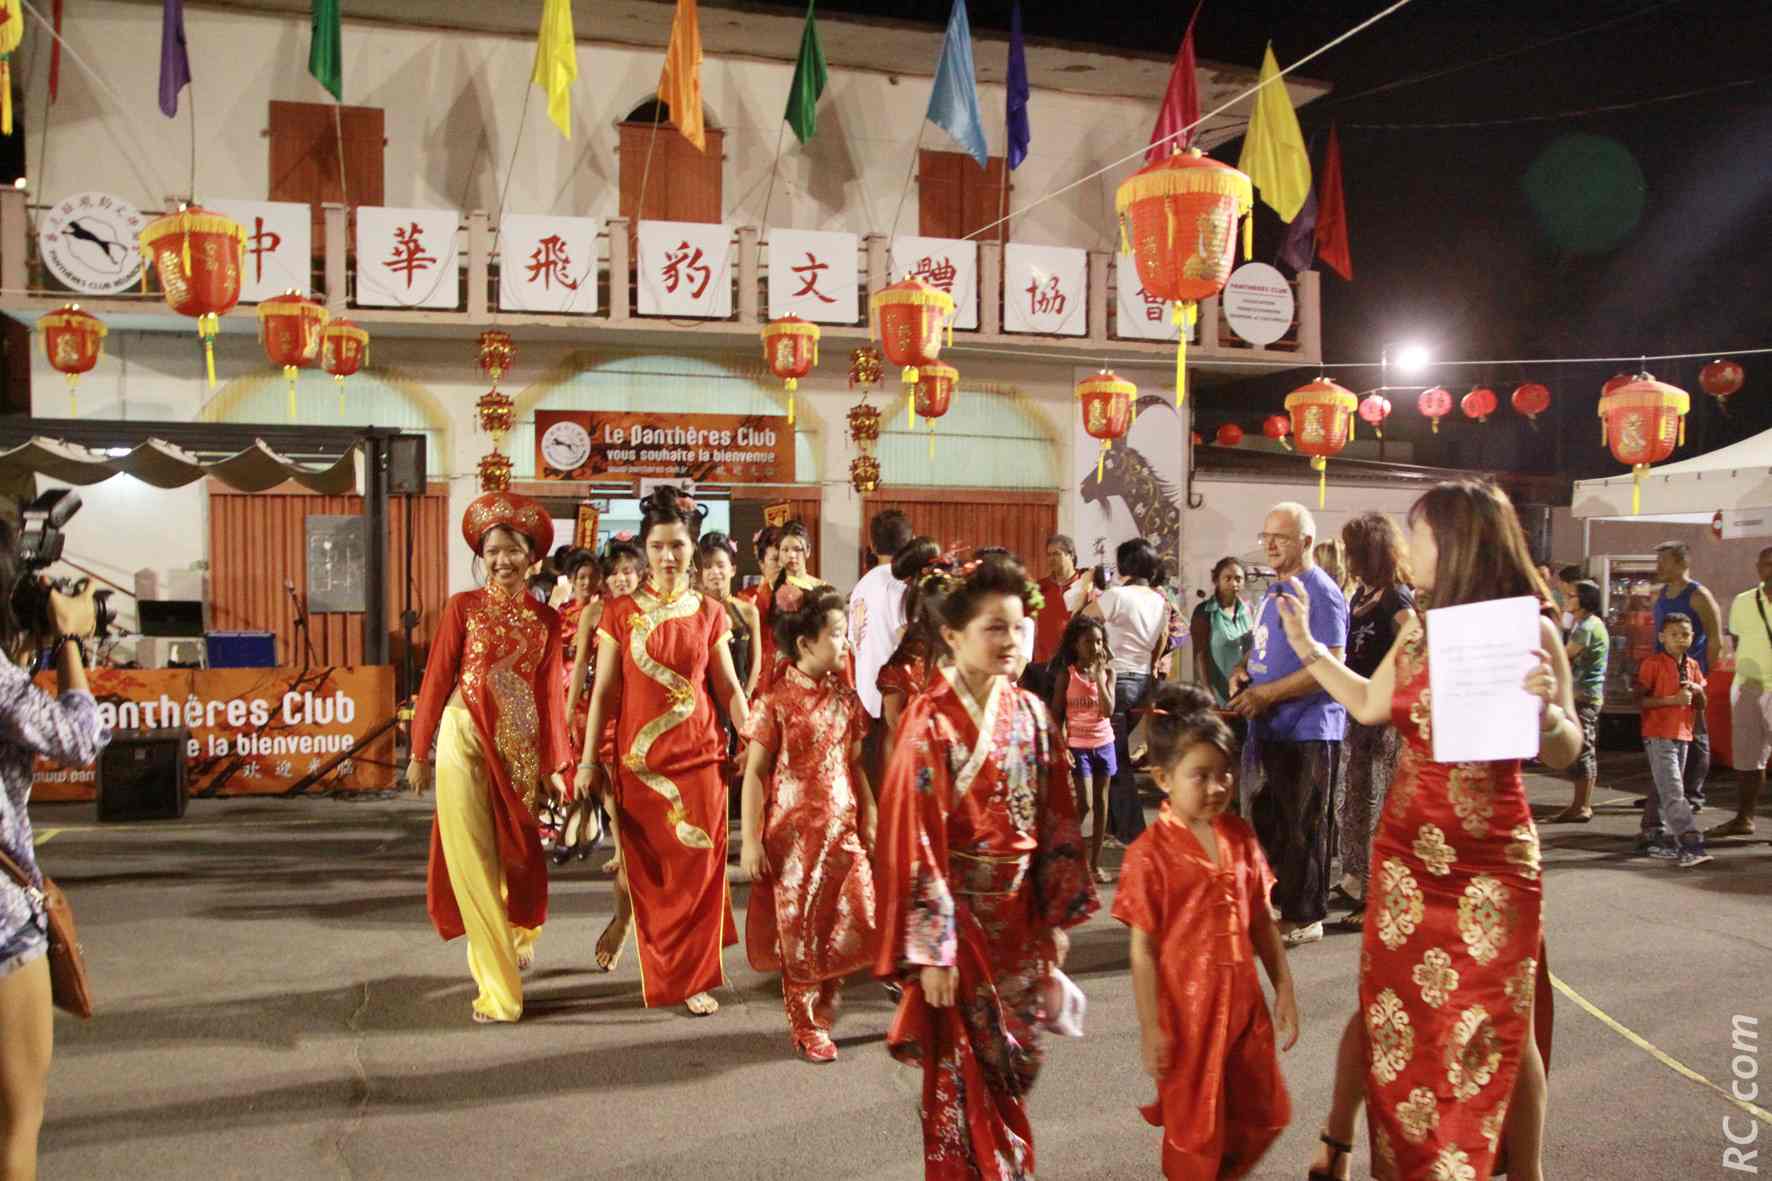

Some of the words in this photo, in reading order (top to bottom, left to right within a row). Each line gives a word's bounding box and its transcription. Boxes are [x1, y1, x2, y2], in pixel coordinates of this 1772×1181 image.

[247, 216, 281, 284] 中
[382, 222, 437, 289] 華
[525, 234, 578, 291] 飛
[660, 240, 711, 299] 豹
[791, 252, 838, 303] 文
[1025, 273, 1067, 316] 協
[604, 423, 625, 444] Le
[631, 424, 732, 446] Panthères
[737, 427, 776, 447] Club
[606, 449, 636, 461] vous
[640, 447, 696, 461] souhaite
[698, 449, 710, 461] la
[712, 449, 776, 463] bienvenue
[99, 694, 271, 729] anthères
[282, 690, 355, 726] Club
[208, 734, 229, 757] la
[236, 733, 355, 757] bienvenue
